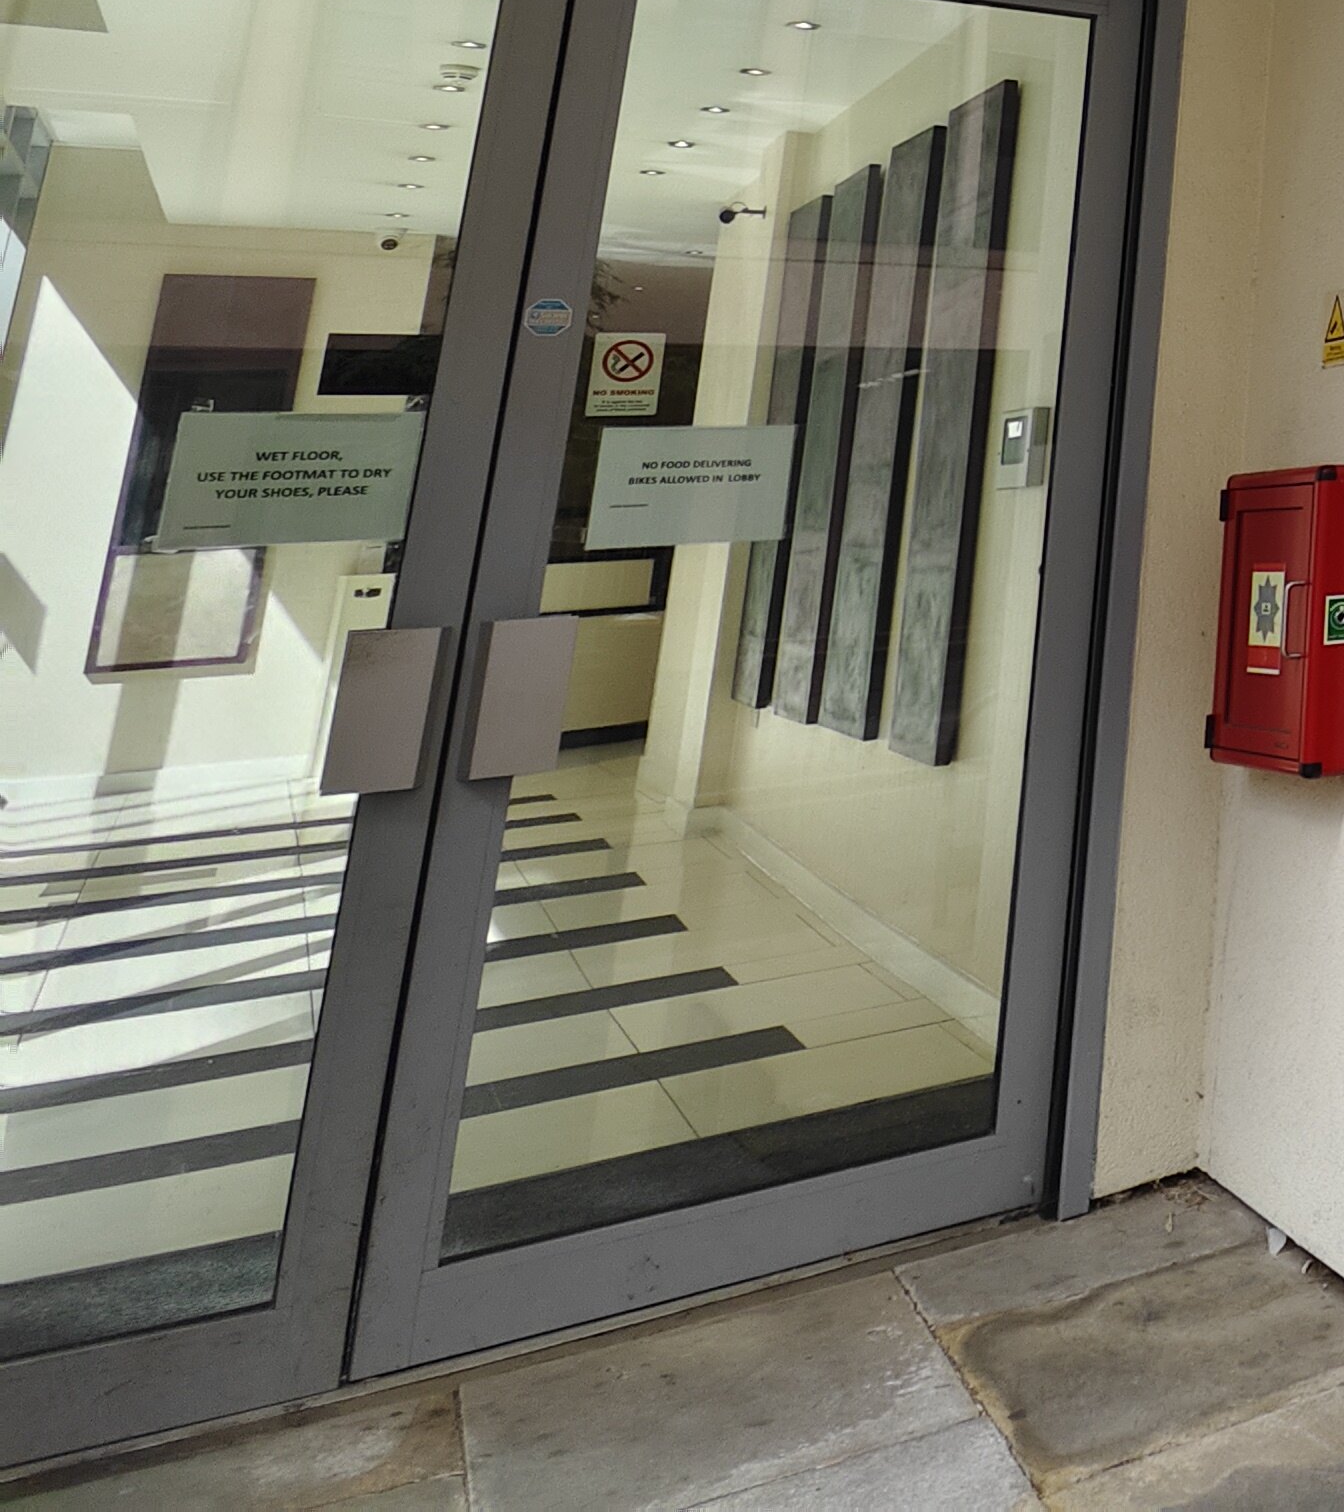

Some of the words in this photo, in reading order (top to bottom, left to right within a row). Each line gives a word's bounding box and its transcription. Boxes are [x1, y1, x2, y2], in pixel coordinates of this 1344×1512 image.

[256, 451, 289, 462] WET
[292, 450, 343, 462] FLOOR,
[641, 461, 658, 470] NO
[660, 460, 691, 469] FOOD
[693, 459, 752, 468] DELIVERING
[197, 471, 226, 482] USE
[230, 470, 259, 481] THE
[262, 469, 336, 481] FOOTMAT
[340, 469, 358, 479] TO
[363, 468, 392, 479] DRY
[628, 476, 657, 485] BIKES
[659, 475, 710, 484] ALLOWED
[712, 474, 723, 483] IN
[727, 473, 761, 483] LOBBY
[215, 488, 258, 500] YOUR
[261, 487, 314, 499] SHOES,
[317, 485, 369, 497] PLEASE
